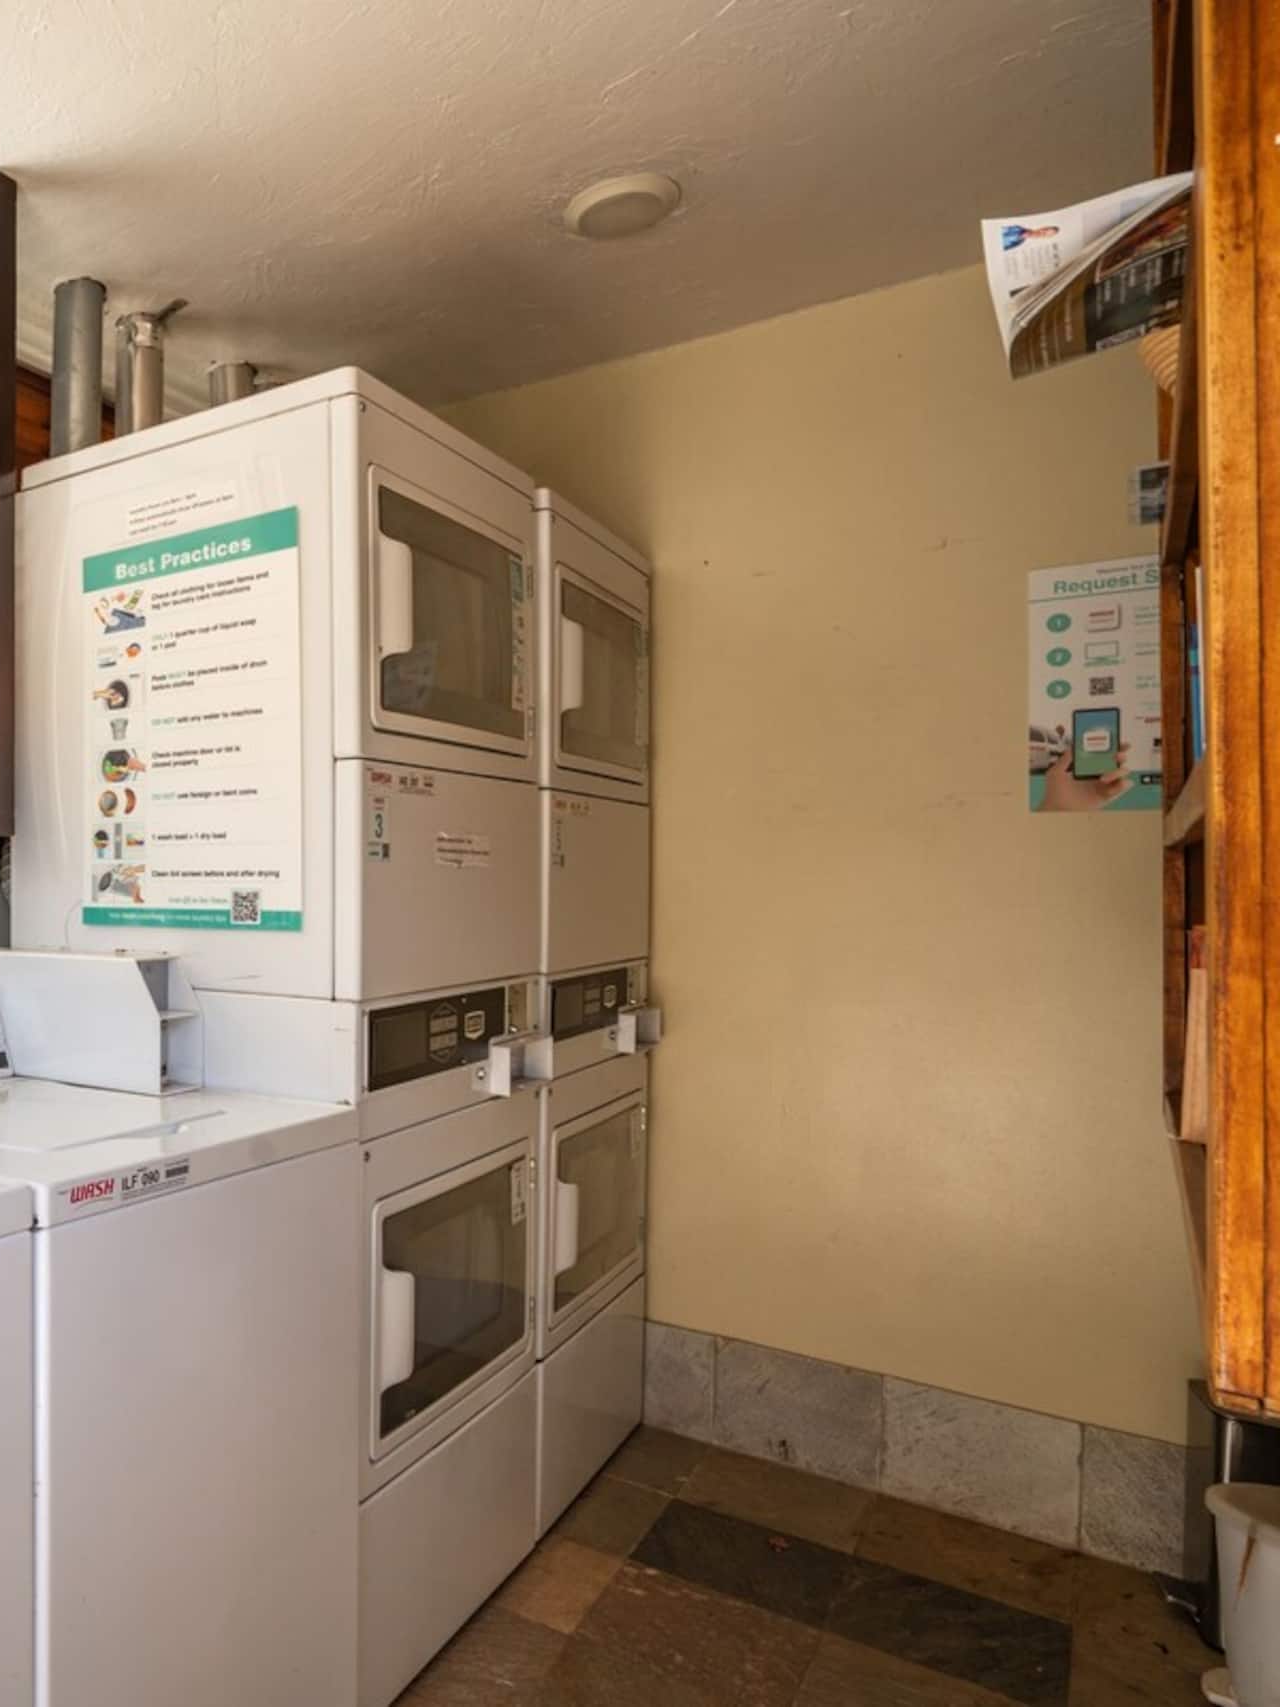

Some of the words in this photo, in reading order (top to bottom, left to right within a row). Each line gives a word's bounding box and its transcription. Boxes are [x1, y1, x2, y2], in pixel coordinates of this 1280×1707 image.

[114, 557, 156, 580] Best
[160, 537, 252, 571] Practices
[1053, 573, 1138, 594] Request
[374, 813, 384, 839] 3
[69, 1177, 115, 1204] WASH
